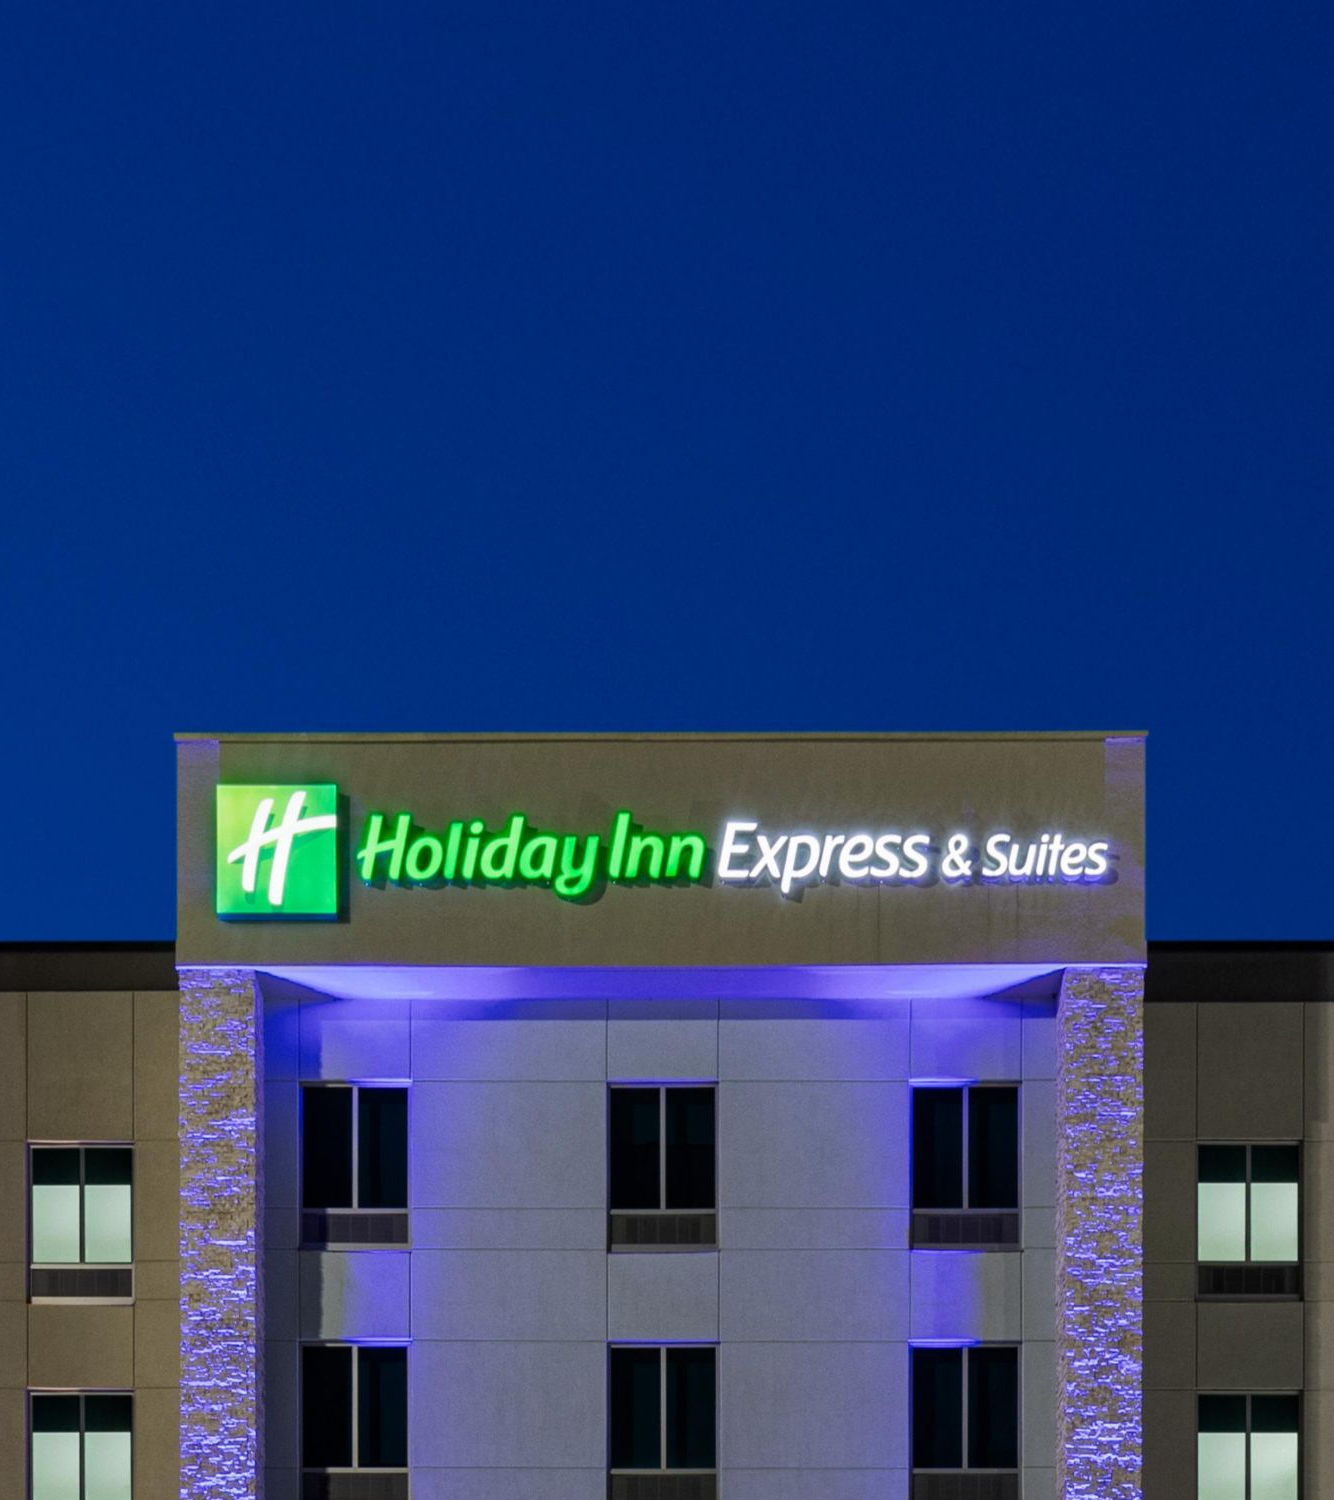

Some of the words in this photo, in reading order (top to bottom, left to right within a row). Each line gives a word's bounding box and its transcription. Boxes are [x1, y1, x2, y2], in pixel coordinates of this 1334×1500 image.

[356, 814, 600, 896] Holiday
[608, 812, 705, 879] Inn
[717, 821, 930, 893] Express
[941, 833, 972, 876] &
[981, 833, 1109, 877] Suites
